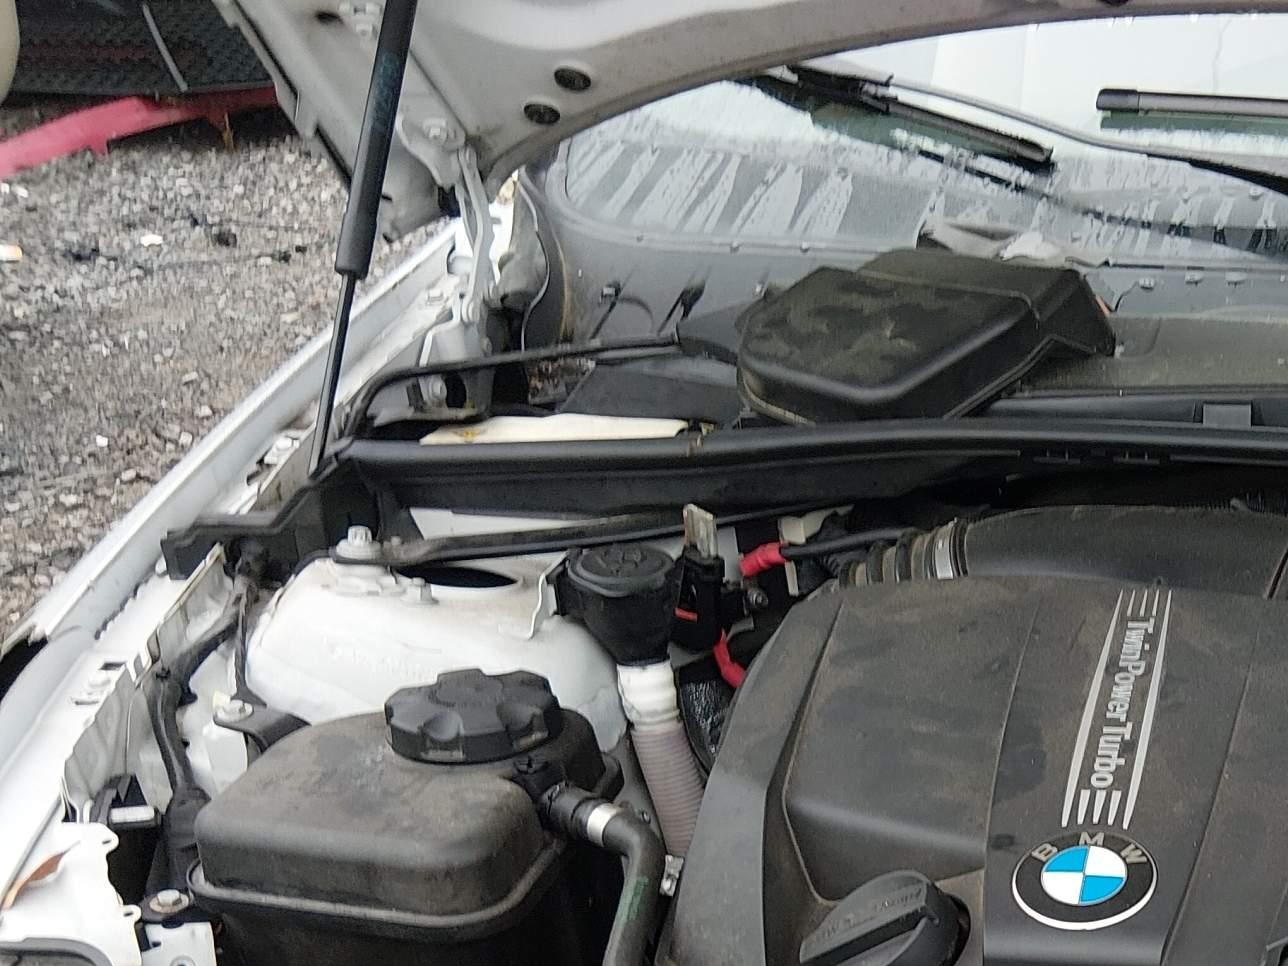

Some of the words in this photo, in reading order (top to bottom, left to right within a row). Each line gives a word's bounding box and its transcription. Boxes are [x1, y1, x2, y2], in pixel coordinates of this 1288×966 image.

[1105, 617, 1155, 722] TwinPower
[1090, 722, 1134, 788] Turbo
[1031, 831, 1148, 864] BMW
